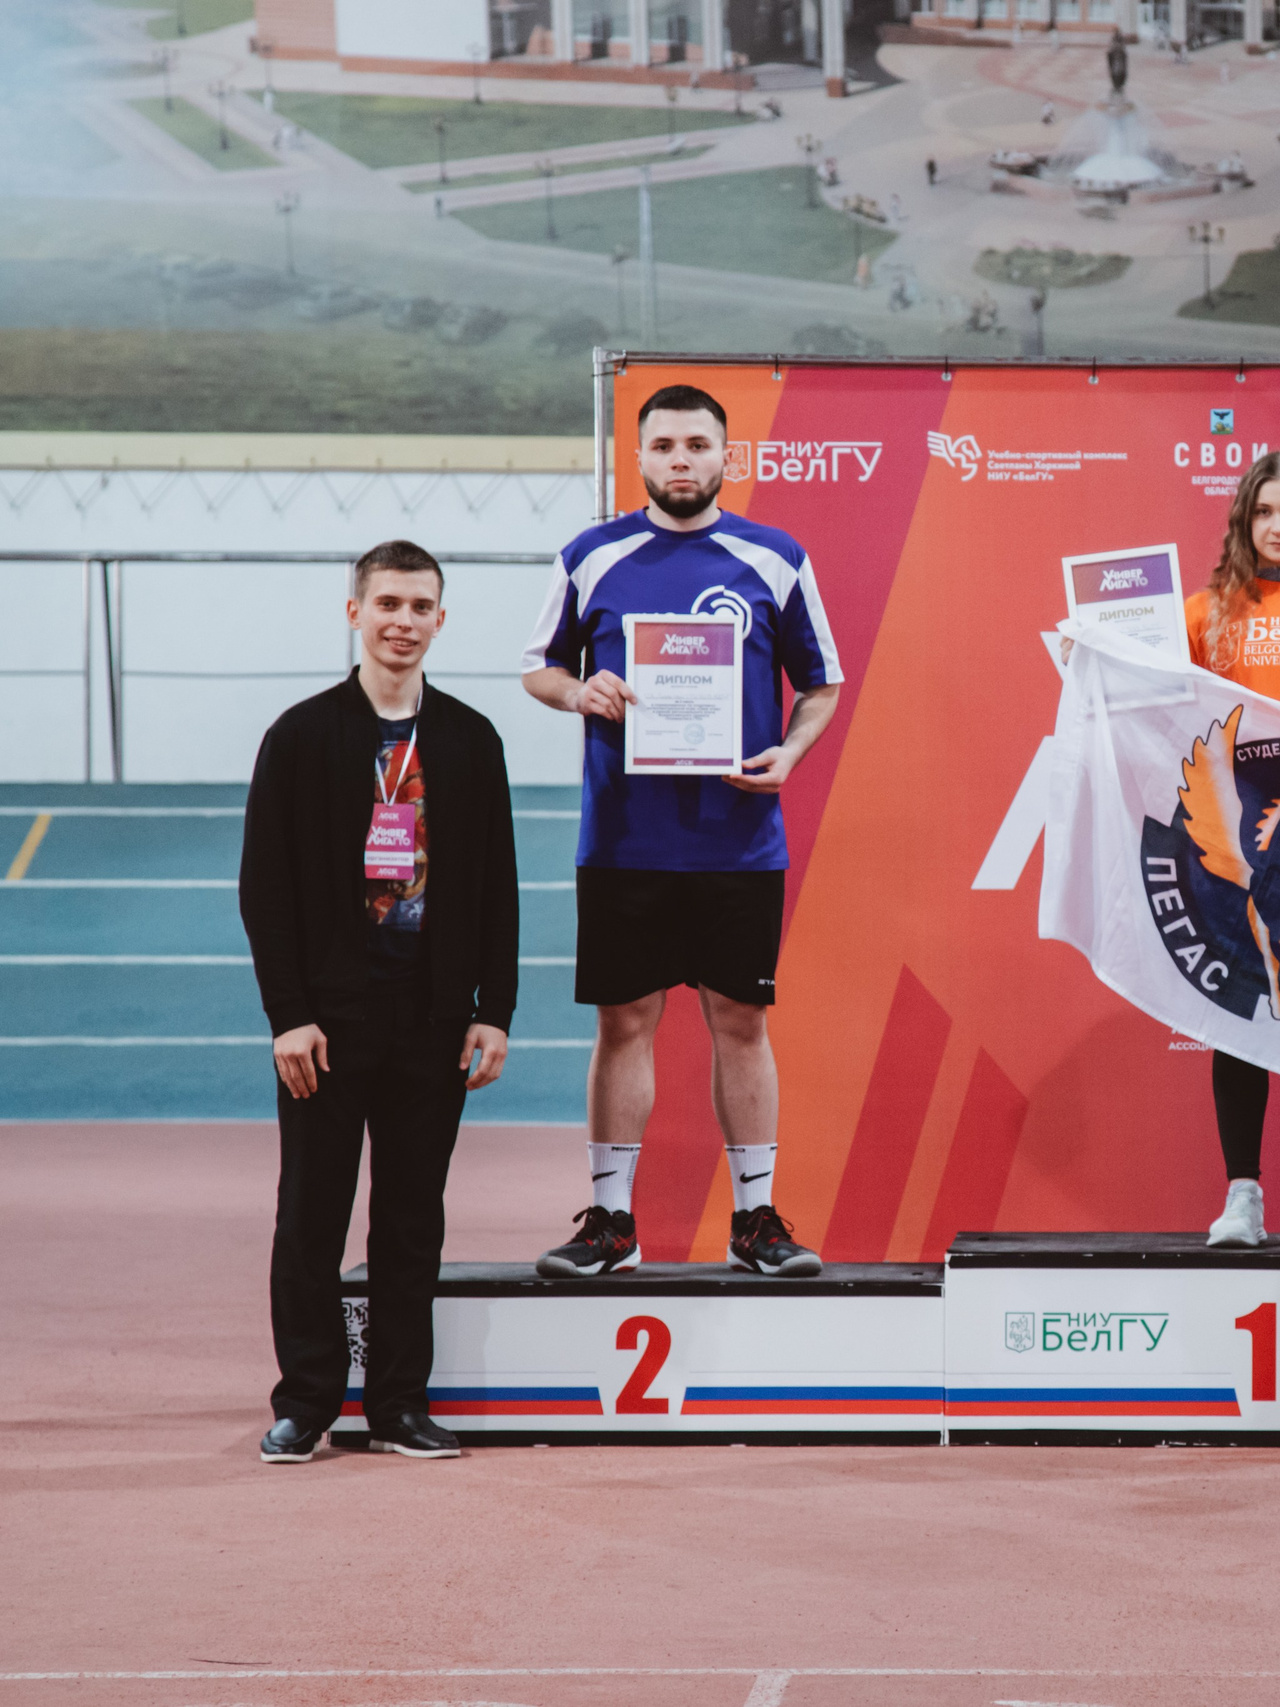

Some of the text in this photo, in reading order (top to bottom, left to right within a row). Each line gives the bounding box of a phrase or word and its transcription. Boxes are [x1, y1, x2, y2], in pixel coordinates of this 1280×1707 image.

[781, 441, 826, 457] НИУ
[757, 447, 882, 482] БелГУ
[987, 472, 1010, 480] НИУ
[1191, 476, 1243, 485] БЕЛГОРОДС
[1099, 606, 1154, 622] ДИПЛОМ
[655, 675, 713, 686] ДИПЛОМ
[1147, 857, 1229, 991] ПЕГАС
[1067, 1313, 1112, 1327] НИУ
[1042, 1318, 1168, 1352] БелГУ
[1235, 1302, 1276, 1401] 1
[615, 1316, 671, 1414] 2
